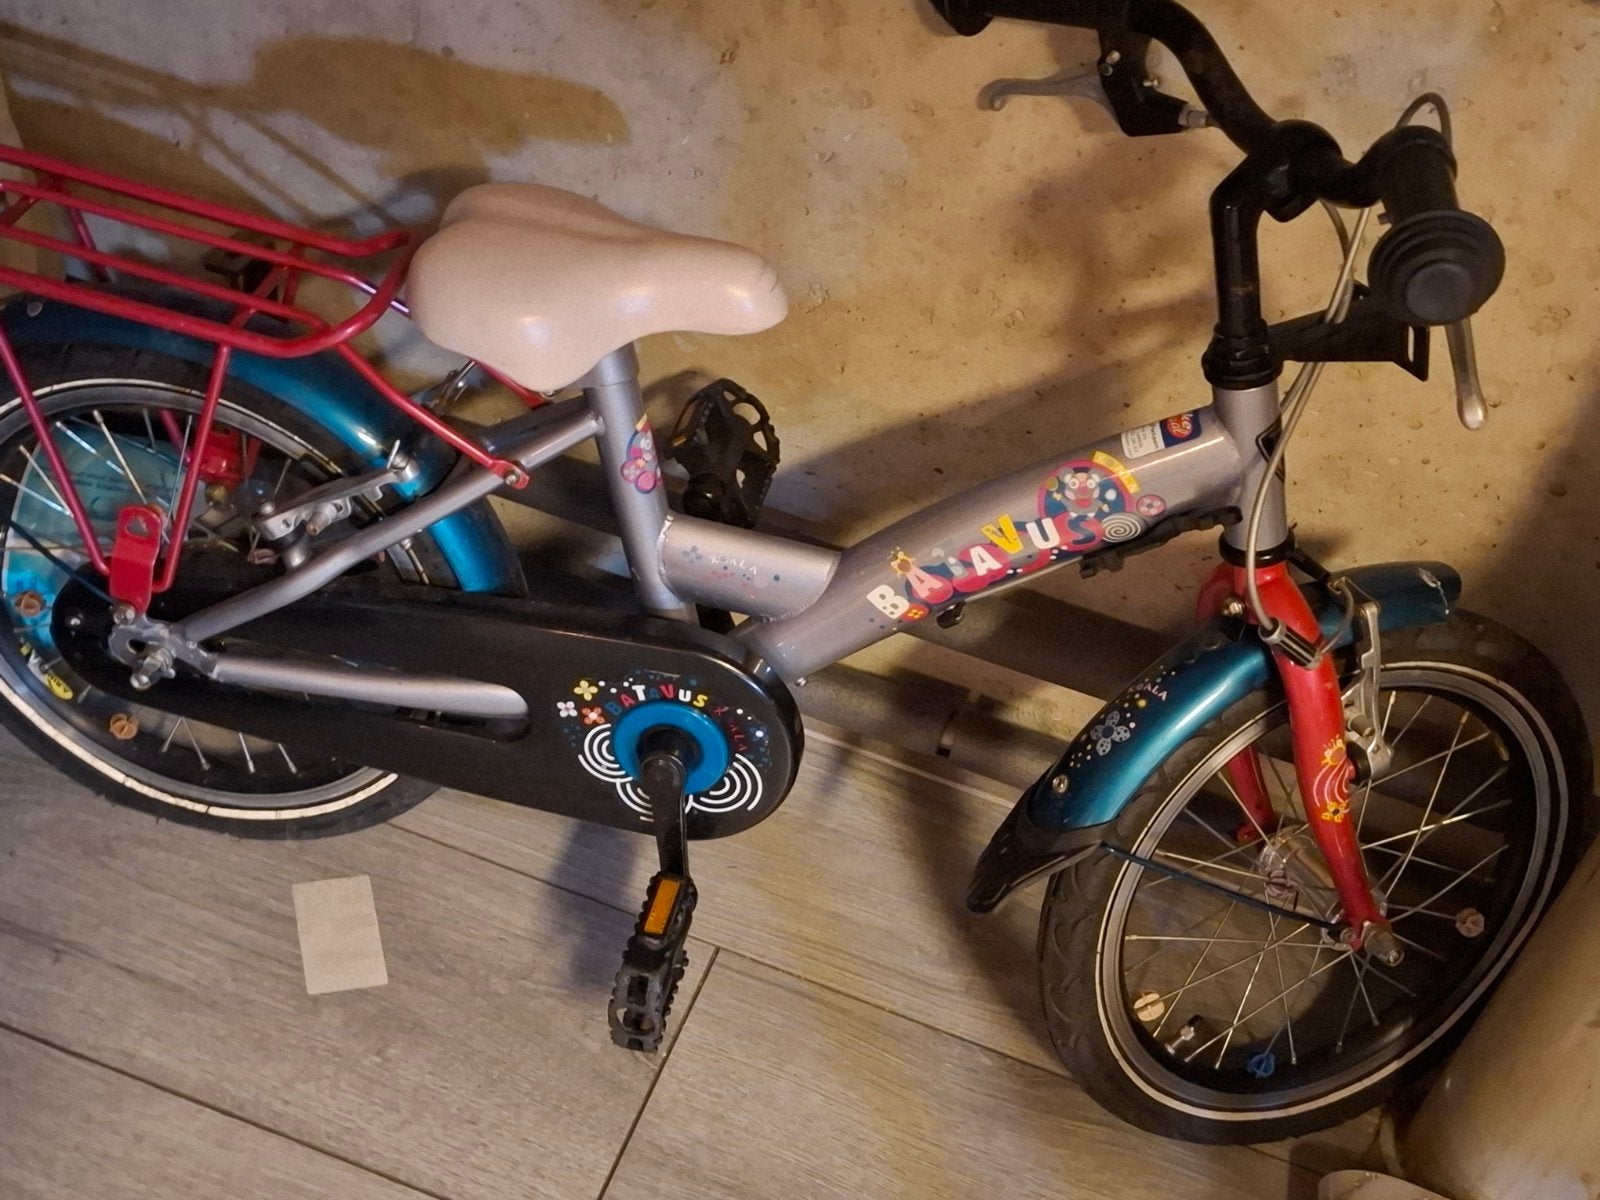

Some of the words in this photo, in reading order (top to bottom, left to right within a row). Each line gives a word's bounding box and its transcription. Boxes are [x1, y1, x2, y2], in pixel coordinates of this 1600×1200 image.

[711, 554, 757, 575] KOALA
[866, 514, 1098, 619] BAAVUS
[604, 684, 709, 716] BATAVUS
[714, 705, 748, 752] KALA
